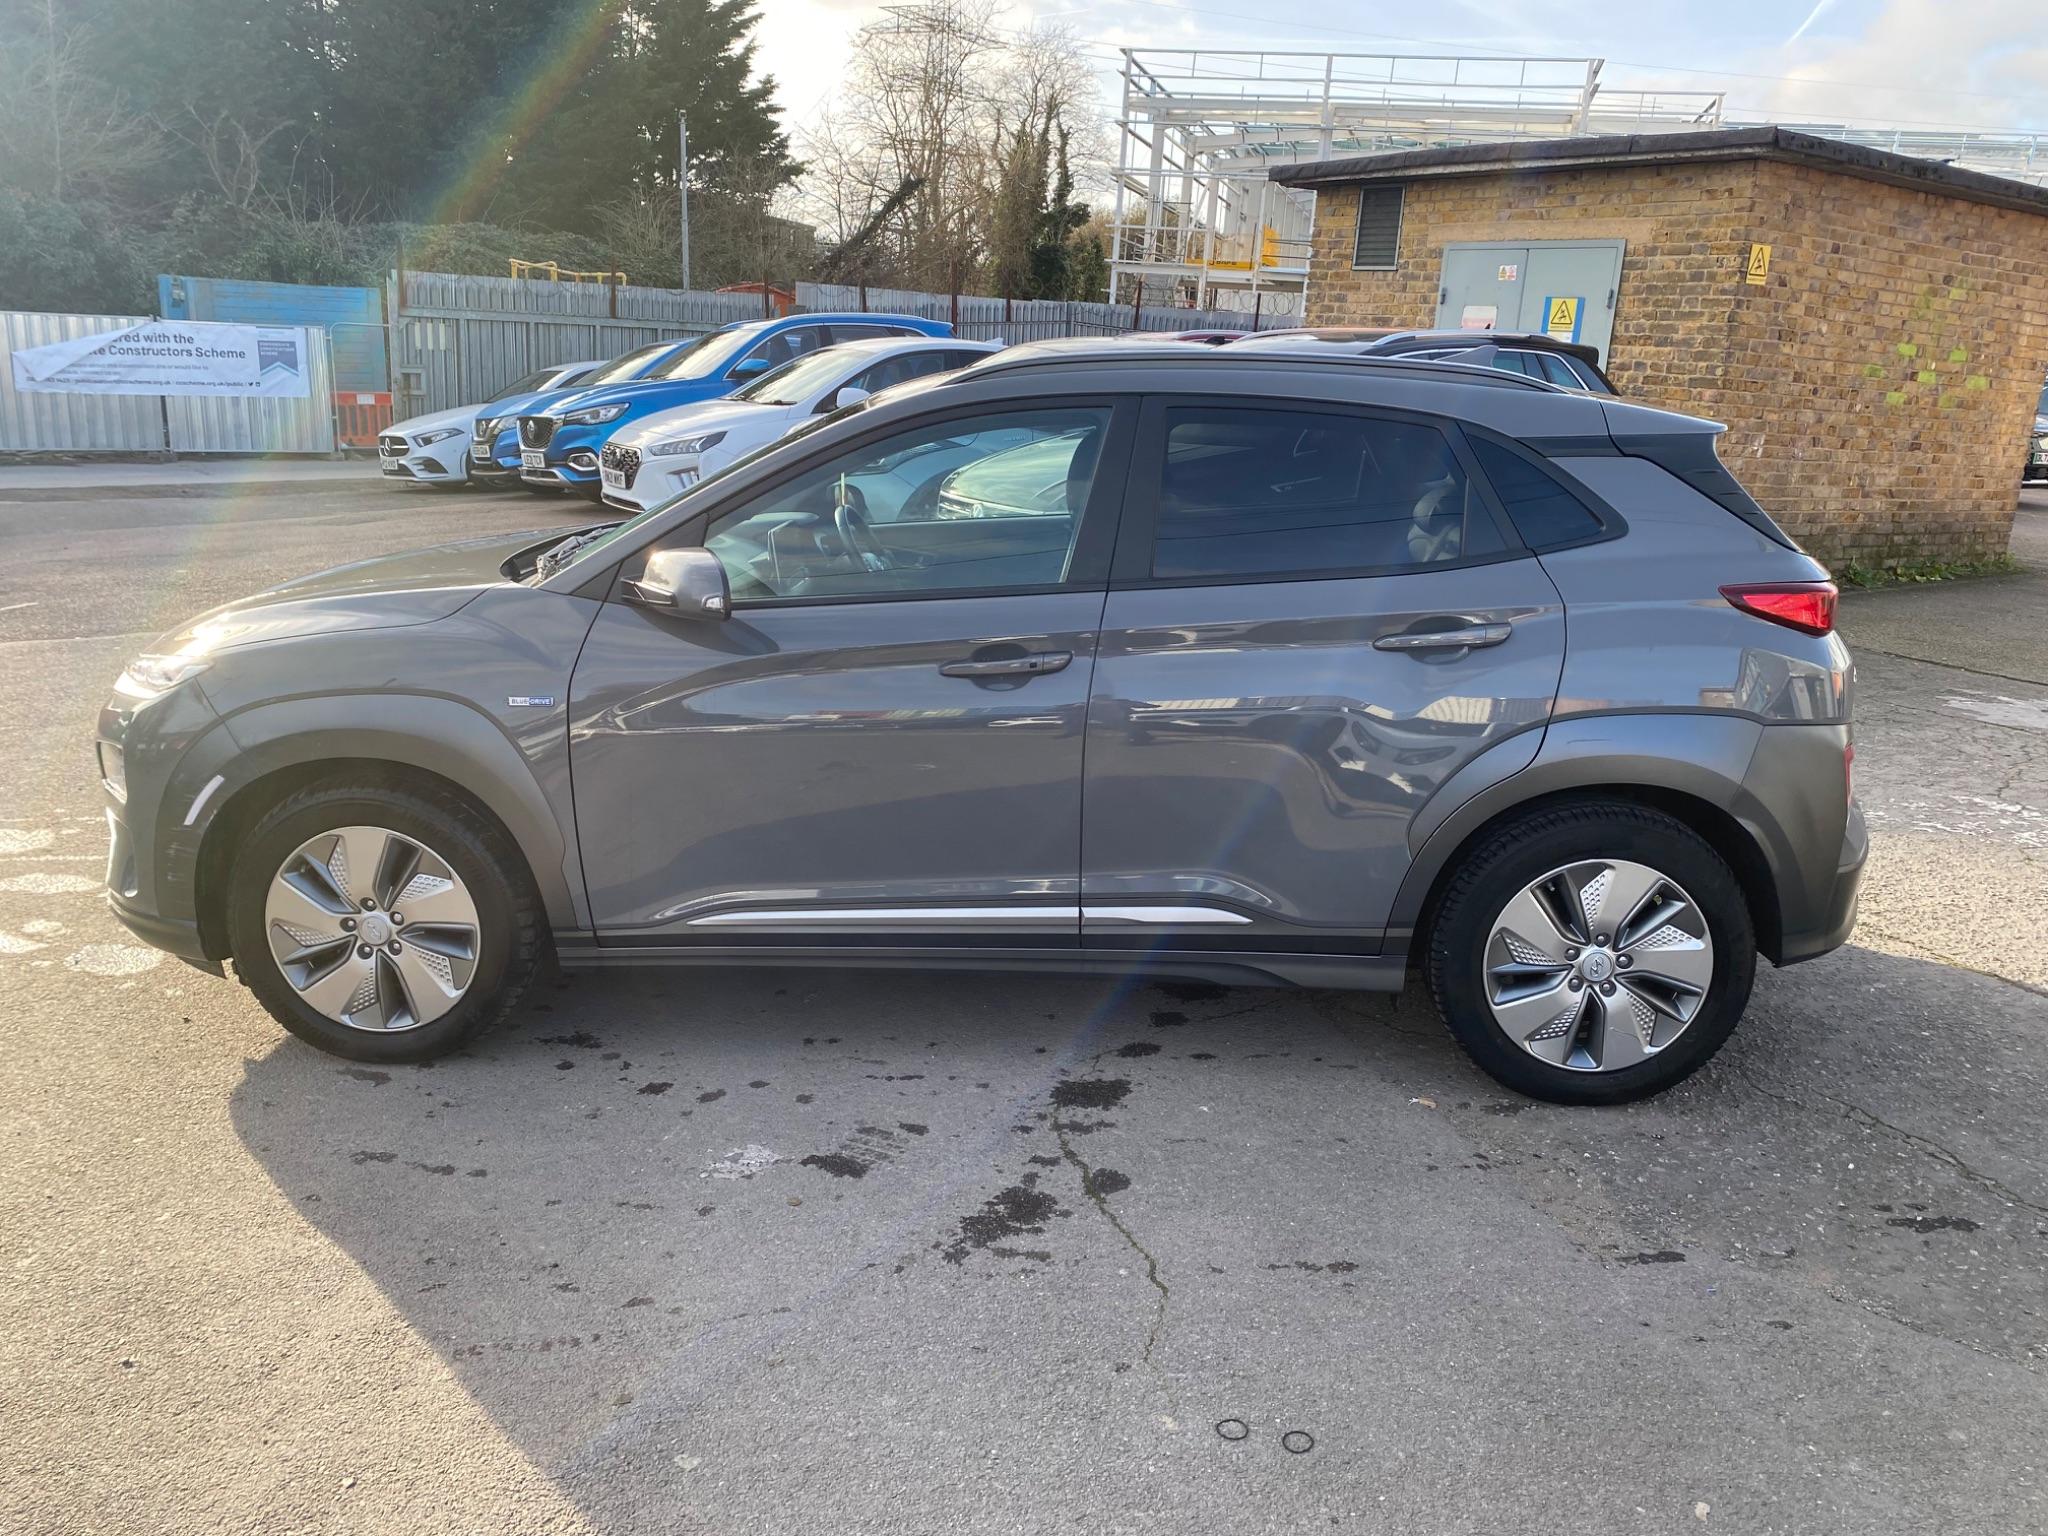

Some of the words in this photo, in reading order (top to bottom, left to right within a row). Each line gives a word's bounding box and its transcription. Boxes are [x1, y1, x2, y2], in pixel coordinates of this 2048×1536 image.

[143, 332, 171, 344] with
[174, 333, 194, 344] the
[108, 345, 193, 357] Constructors
[195, 346, 246, 359] Scheme
